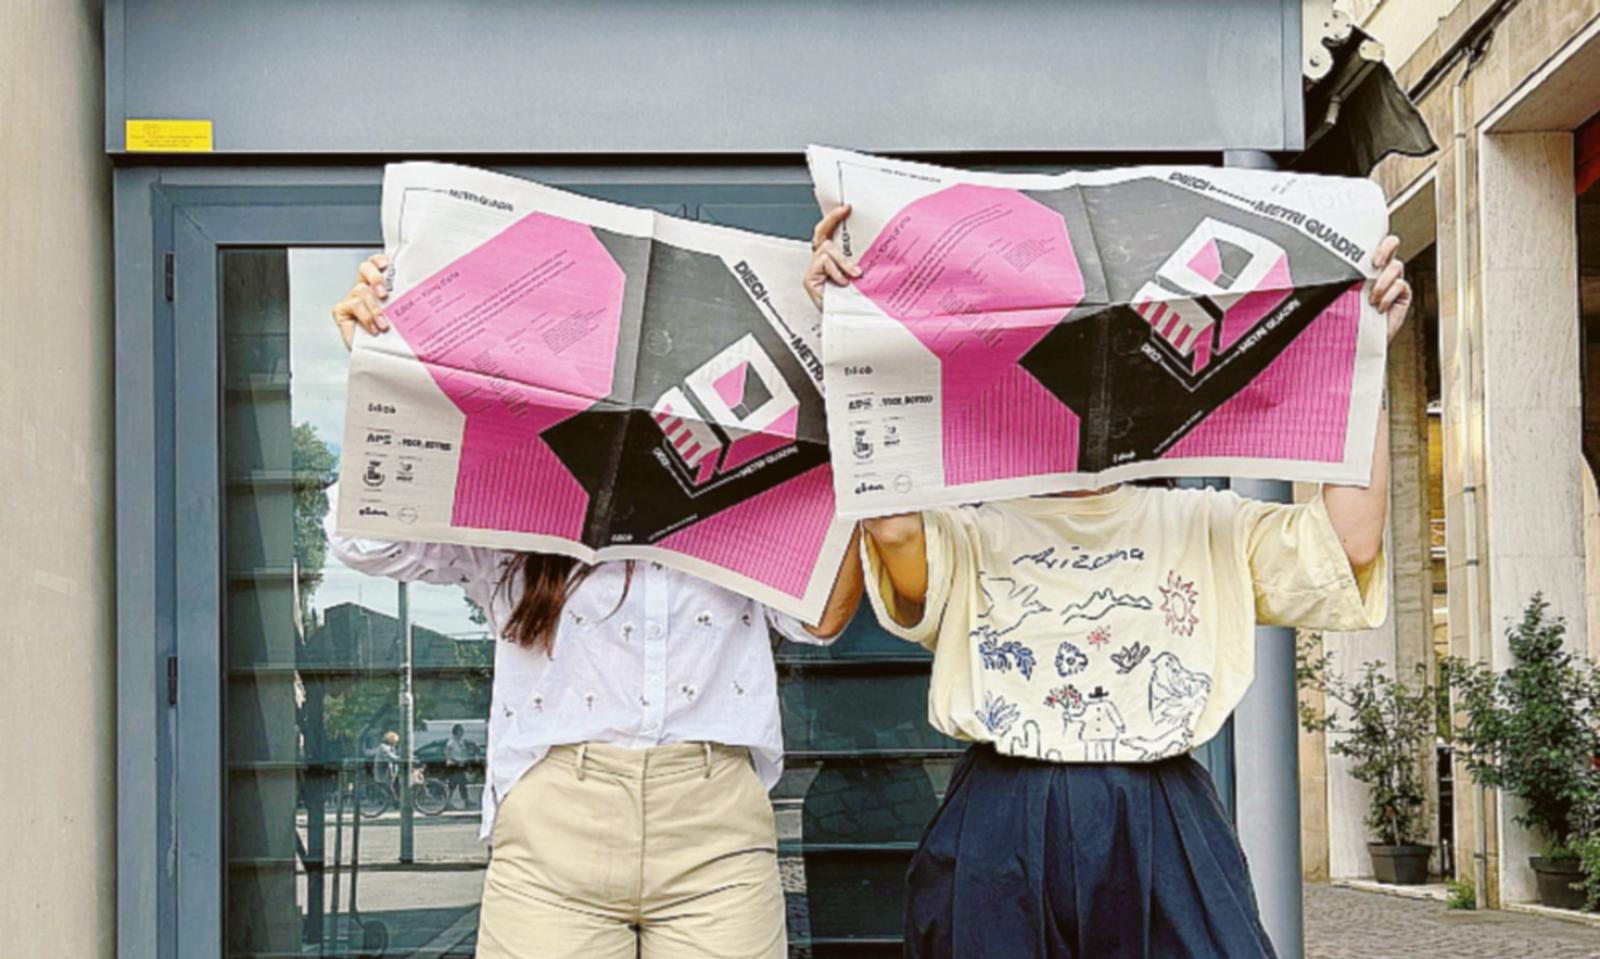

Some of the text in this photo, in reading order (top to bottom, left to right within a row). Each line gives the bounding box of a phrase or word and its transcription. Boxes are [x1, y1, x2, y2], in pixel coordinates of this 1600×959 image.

[1168, 171, 1367, 264] DIECI METRI QUADRI
[733, 259, 826, 393] DIECI METR
